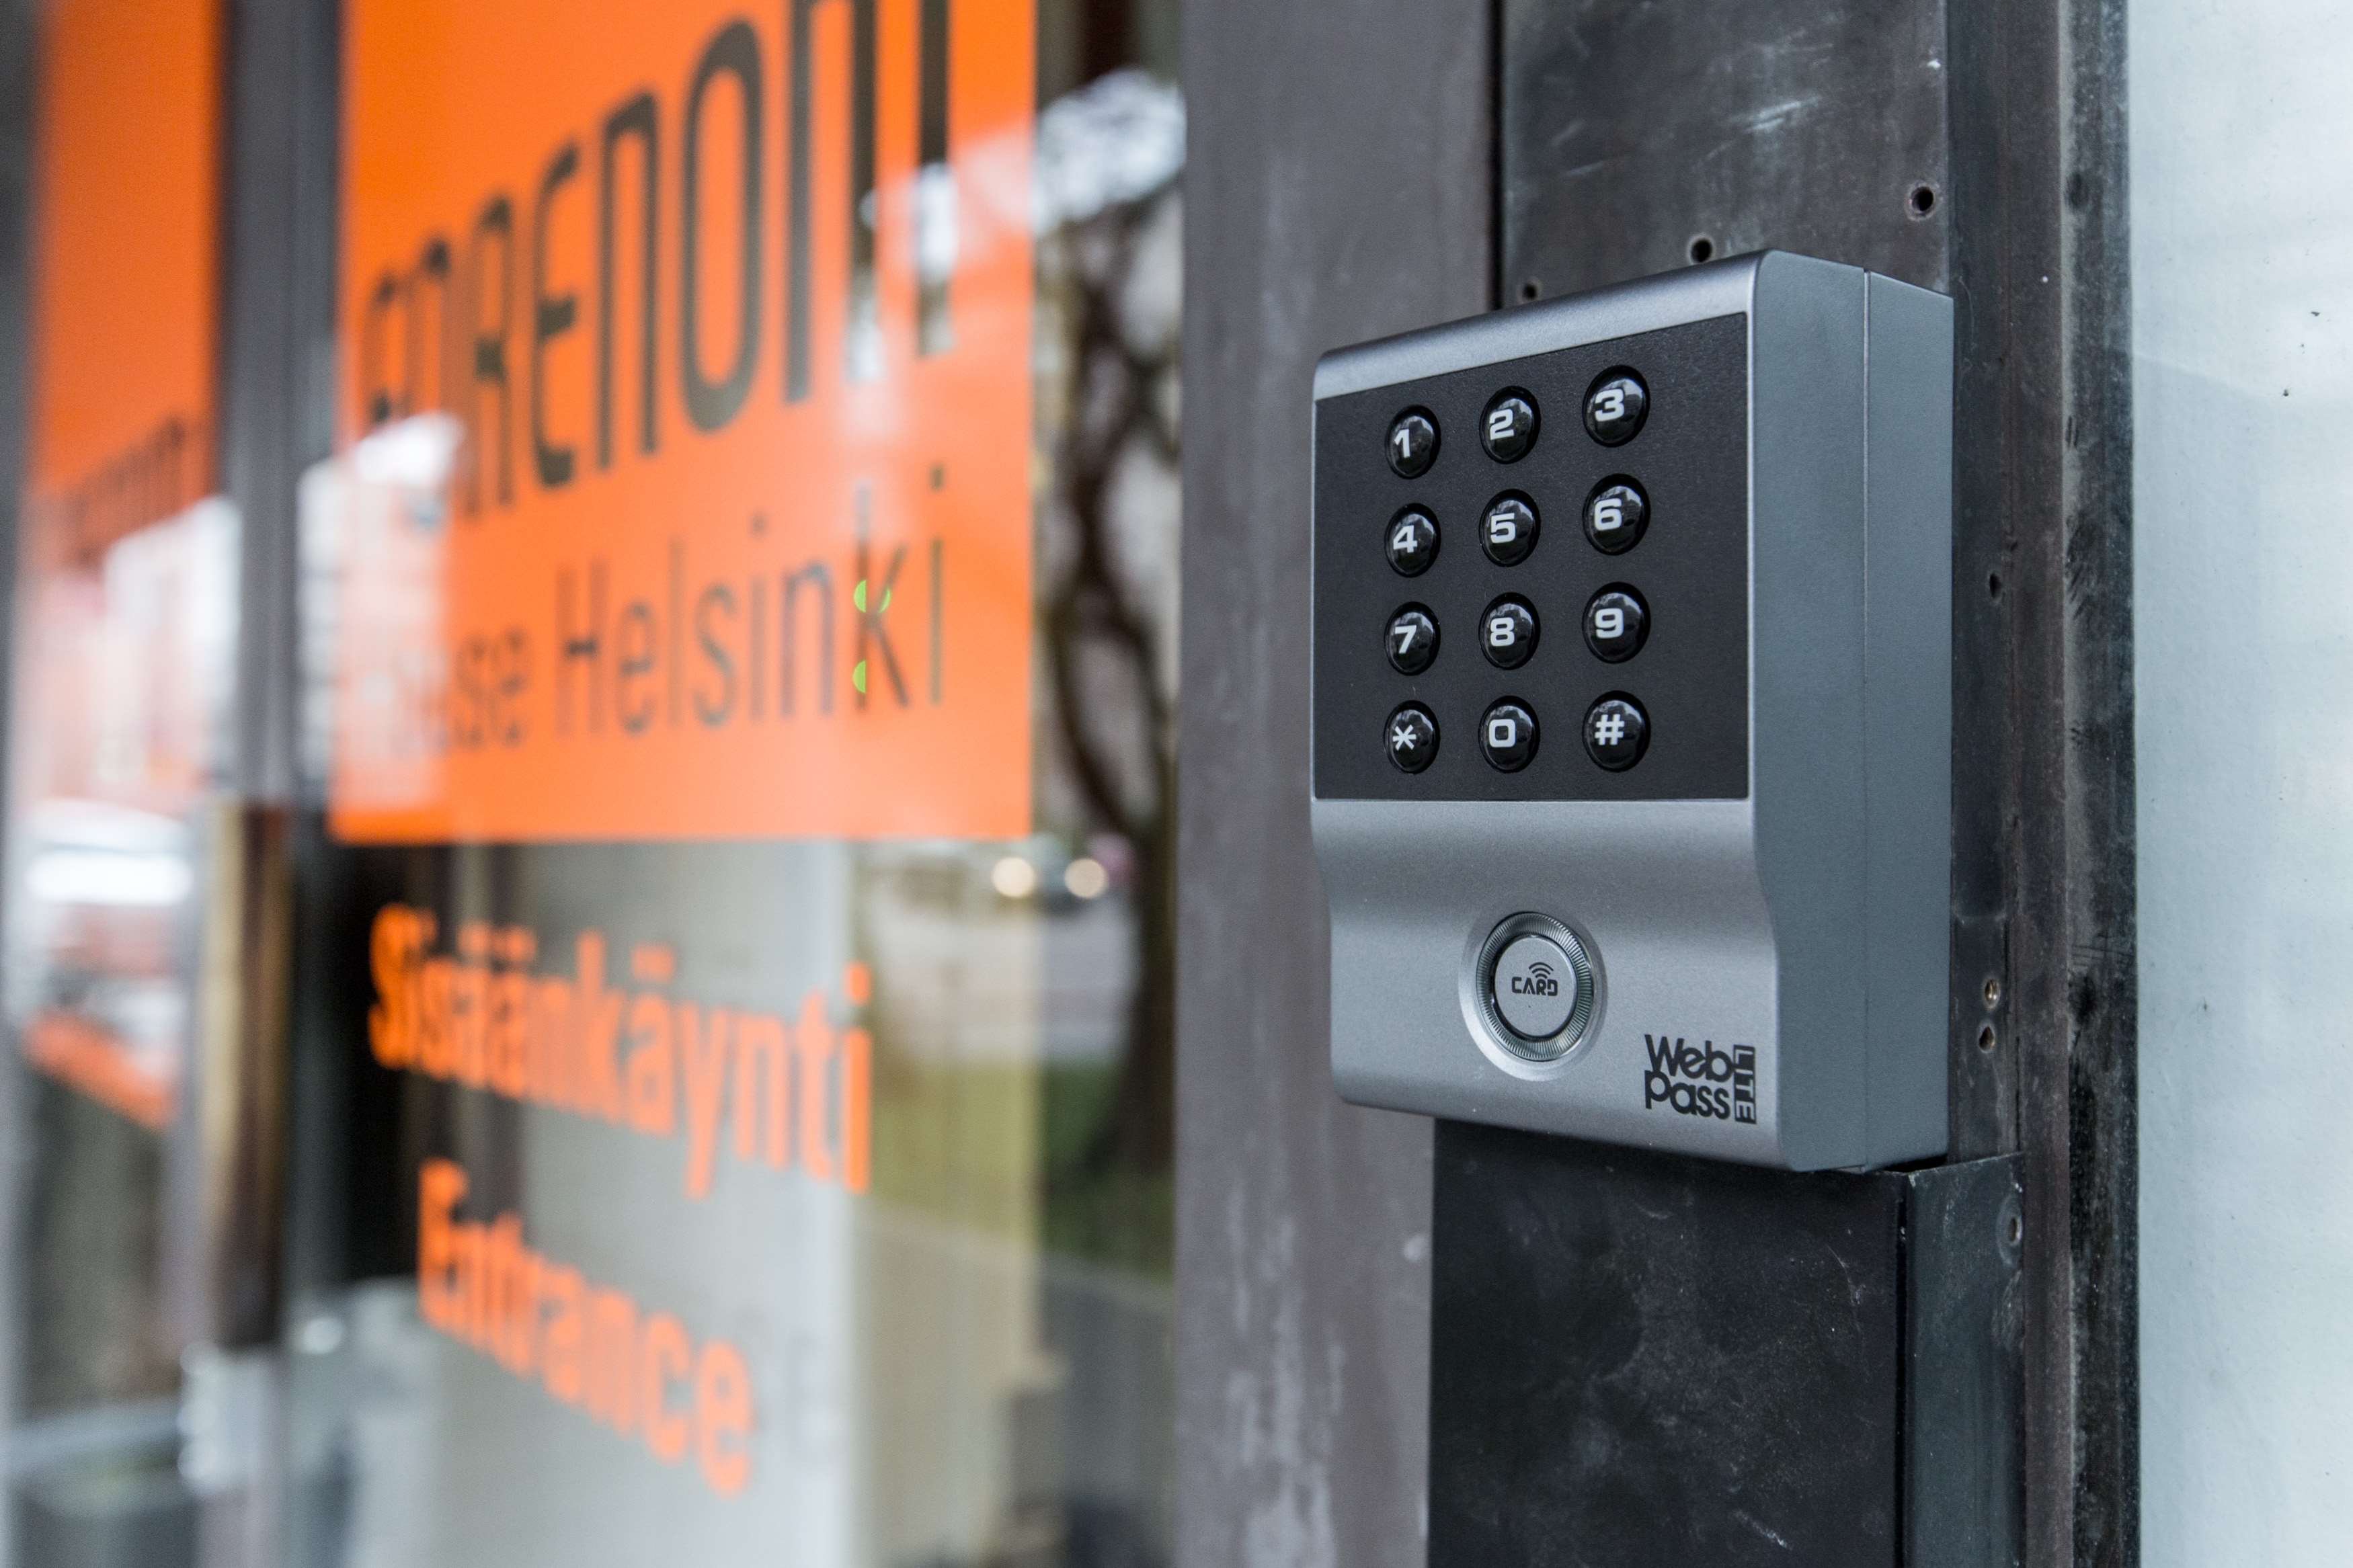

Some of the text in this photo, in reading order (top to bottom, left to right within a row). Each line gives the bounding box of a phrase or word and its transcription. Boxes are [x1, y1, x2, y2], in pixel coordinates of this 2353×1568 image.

[1393, 388, 1625, 458] 1 2 3
[1393, 498, 1622, 552] 4 5 6
[555, 465, 944, 738] Helsinki
[1394, 608, 1624, 653] 7 8 9
[1488, 718, 1515, 747] 0
[1511, 977, 1558, 996] CARD
[368, 903, 872, 1201] Sisäänkäynti
[1644, 1034, 1734, 1082] Web
[1734, 1046, 1755, 1122] LITE
[418, 1159, 755, 1499] Entrance
